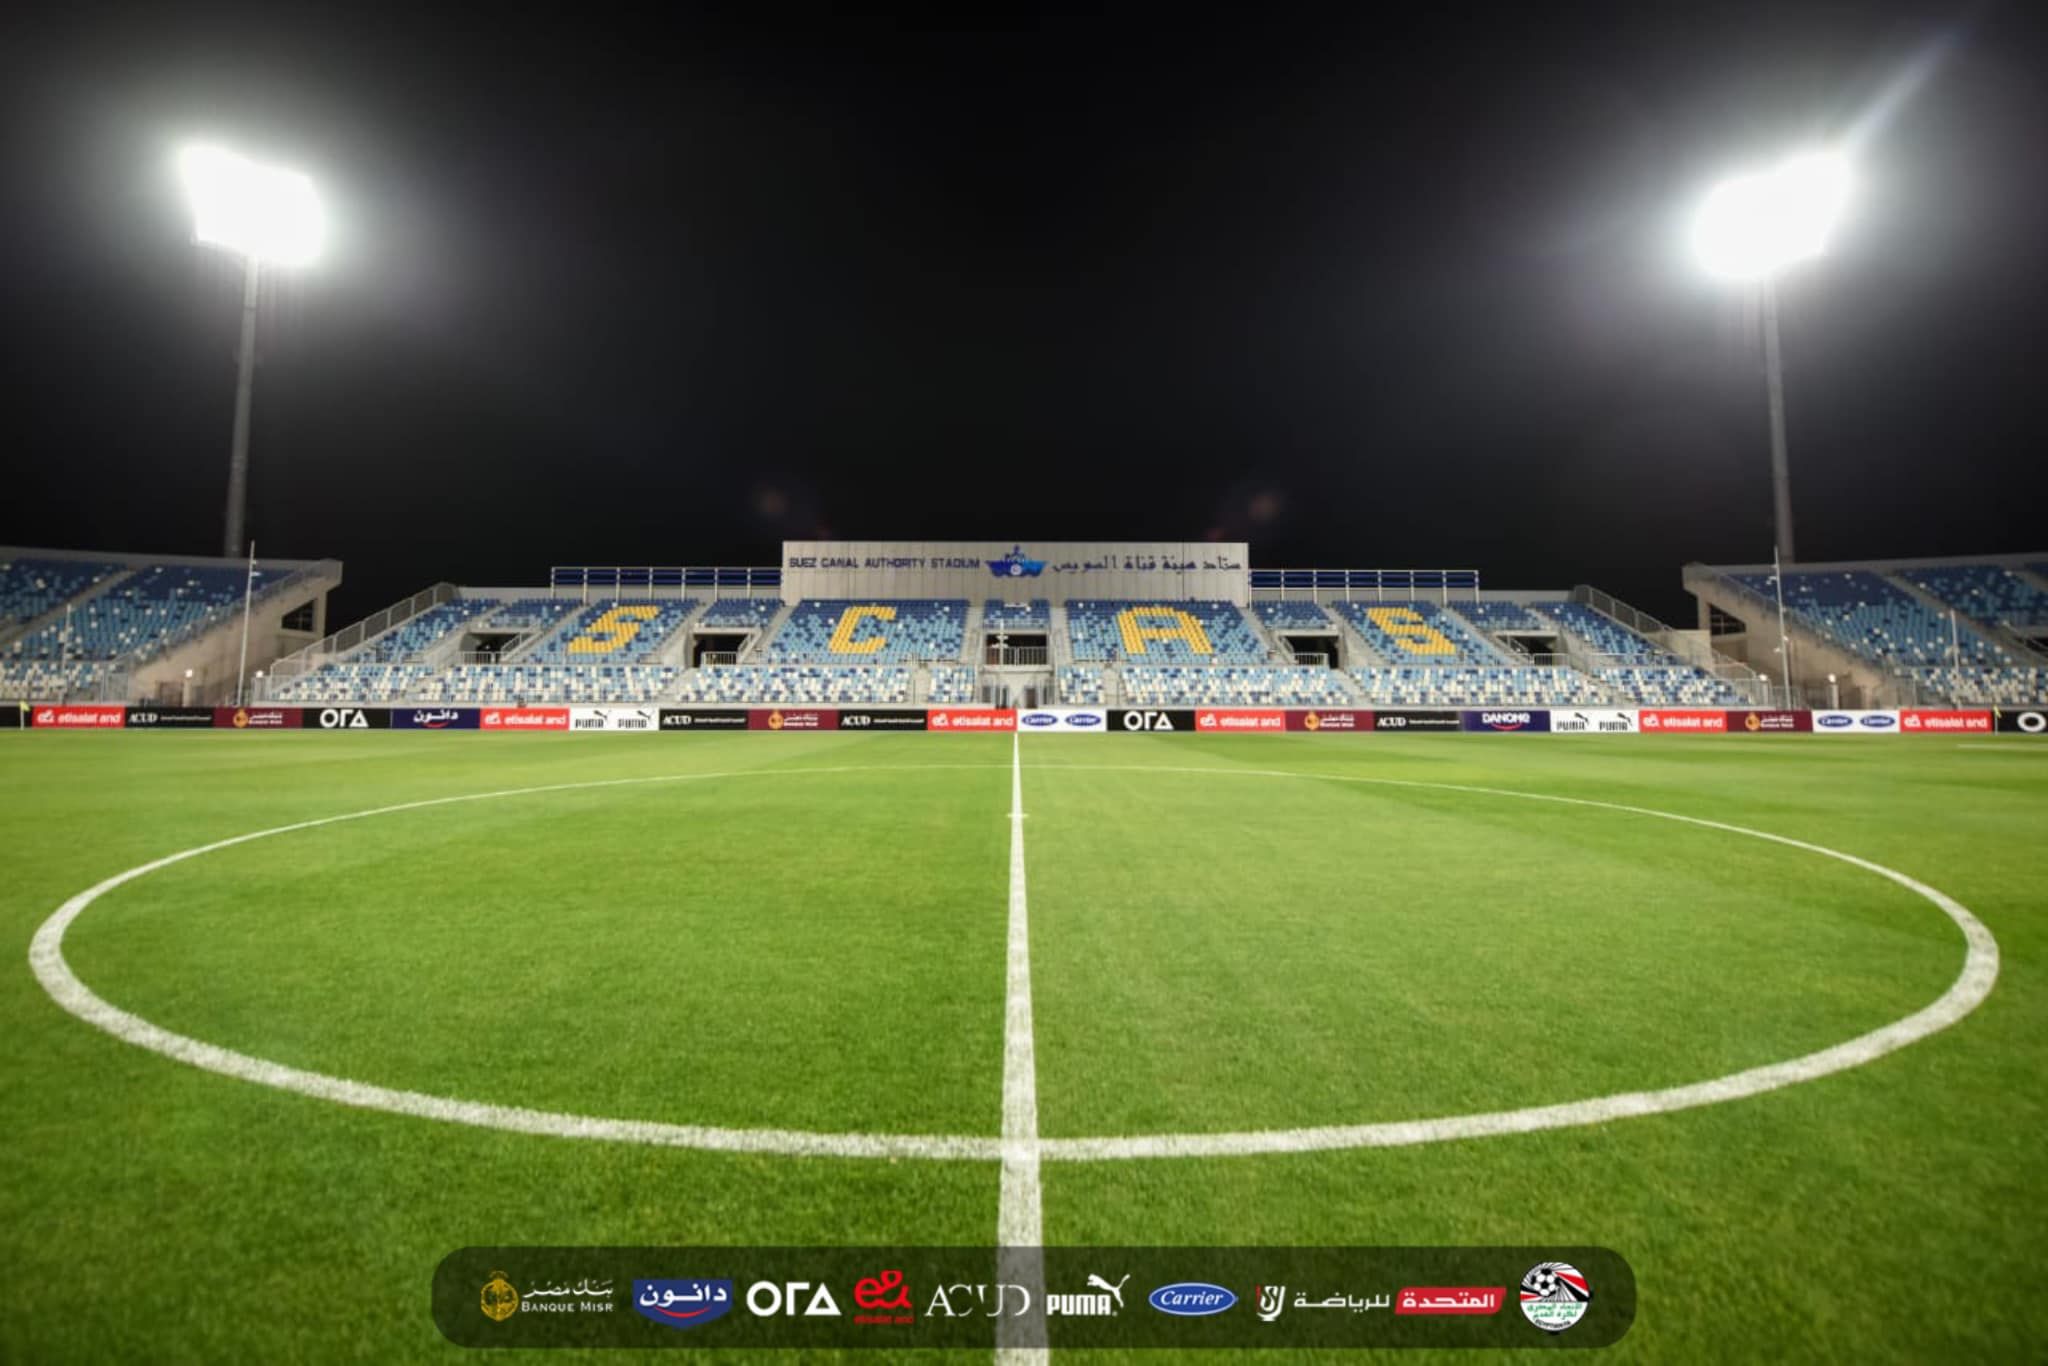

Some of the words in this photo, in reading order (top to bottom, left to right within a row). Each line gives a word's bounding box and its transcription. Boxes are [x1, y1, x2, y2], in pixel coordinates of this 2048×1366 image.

[789, 557, 816, 568] SUEZ
[821, 557, 859, 568] CANAL
[864, 557, 925, 568] AUTHORITY
[931, 557, 980, 568] STADIUM
[1052, 555, 1118, 574] السويس
[1123, 555, 1157, 570] قناة
[1202, 556, 1241, 571] ستاد
[567, 605, 660, 654] S
[828, 605, 897, 654] C
[1116, 606, 1213, 654] A
[1366, 607, 1456, 655] S
[128, 713, 158, 723] ACUD
[413, 709, 459, 723] دانون
[662, 715, 692, 725] ACUD
[841, 715, 870, 726] ACUD
[1377, 716, 1406, 727] ACUD
